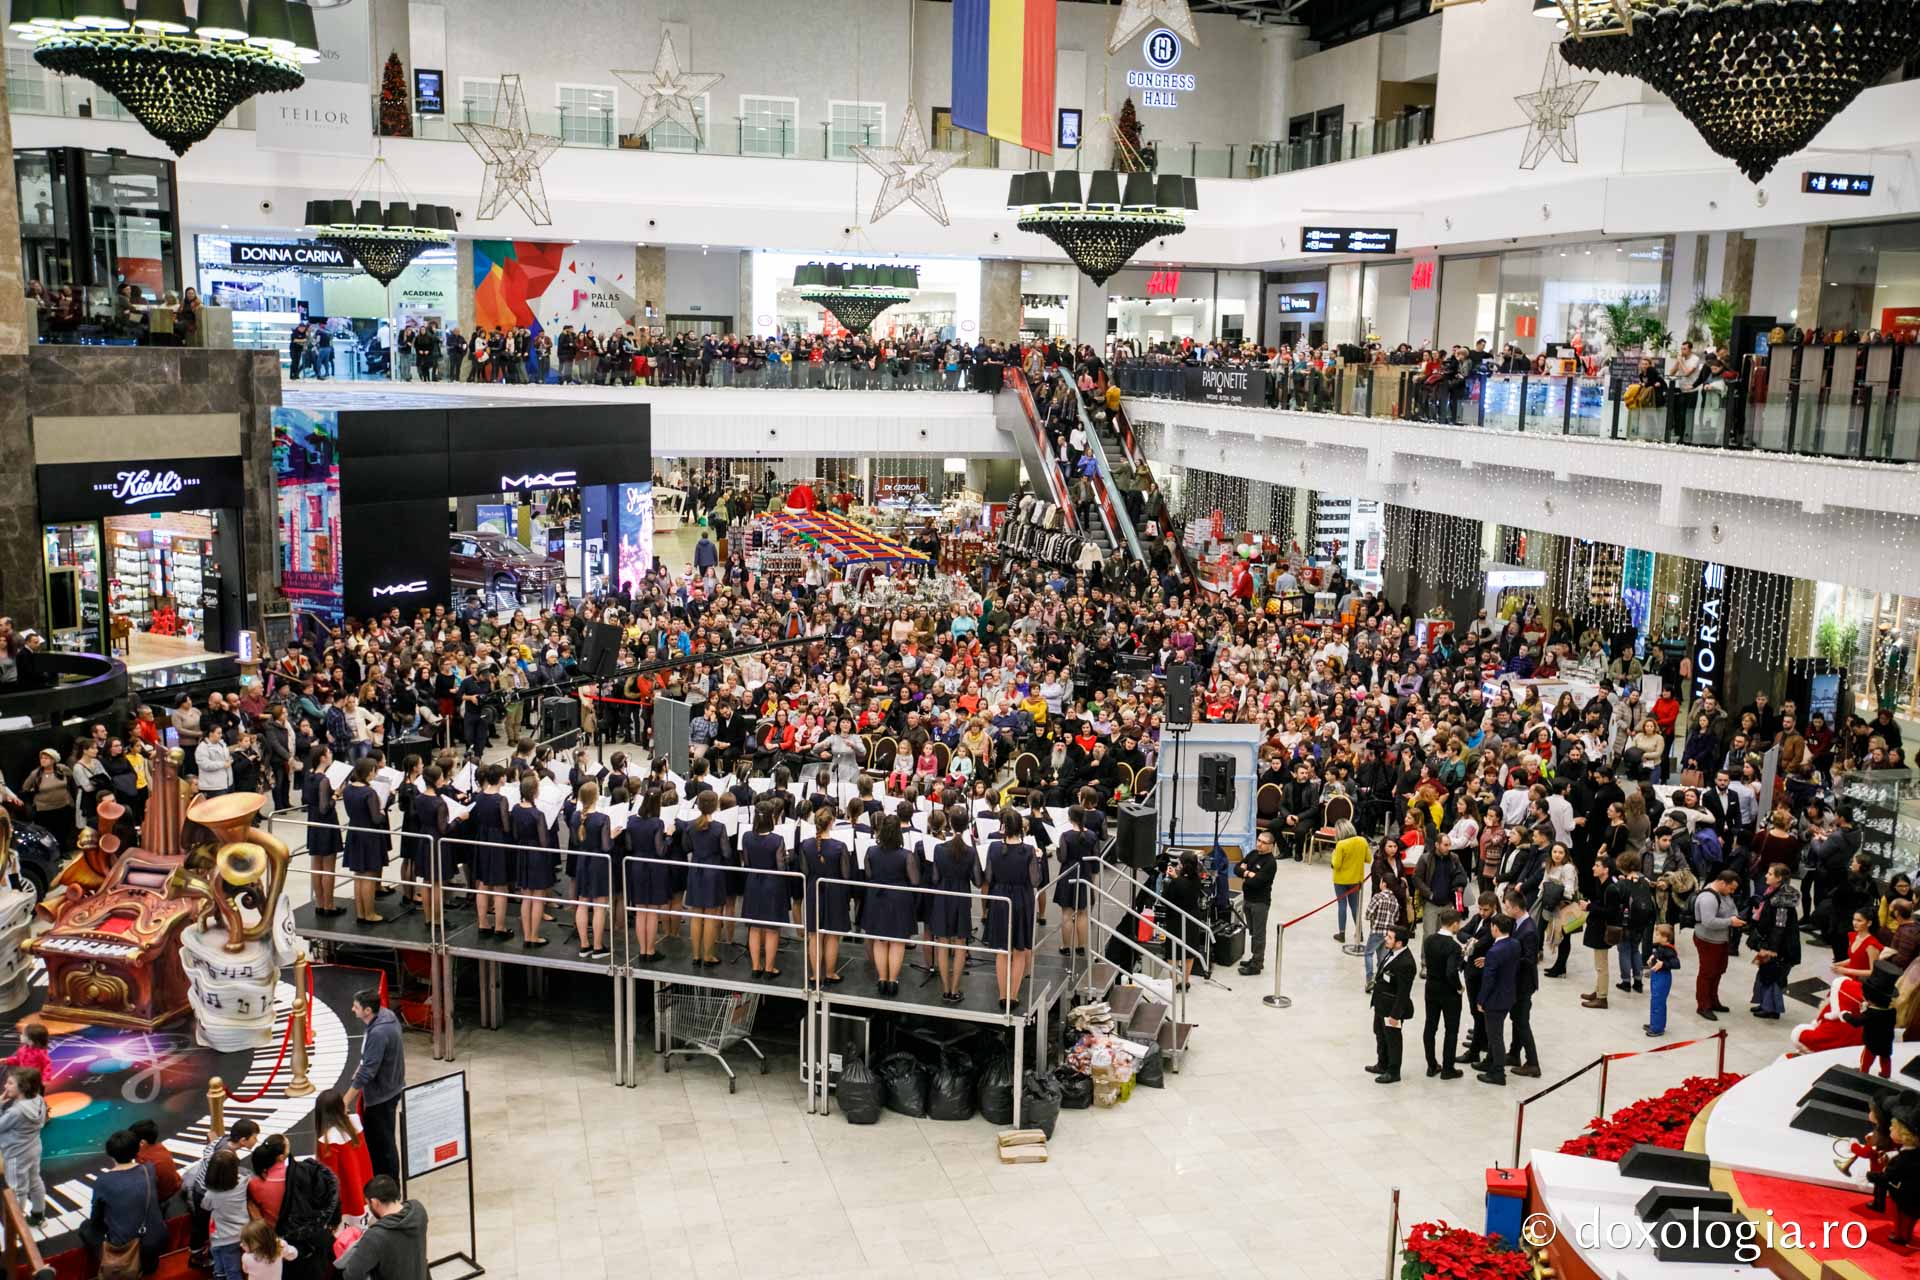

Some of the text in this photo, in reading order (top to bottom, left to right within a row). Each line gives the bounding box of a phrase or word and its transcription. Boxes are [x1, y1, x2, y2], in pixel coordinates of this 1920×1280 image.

[1127, 71, 1195, 89] CONGRESS
[1144, 91, 1177, 106] HALL
[280, 106, 350, 125] TEILOR
[241, 247, 344, 263] DONNA CARINA
[591, 293, 620, 301] PALAS
[591, 301, 616, 309] MALL
[1202, 371, 1248, 390] PAPIONETTE
[112, 469, 182, 499] Kiehl's
